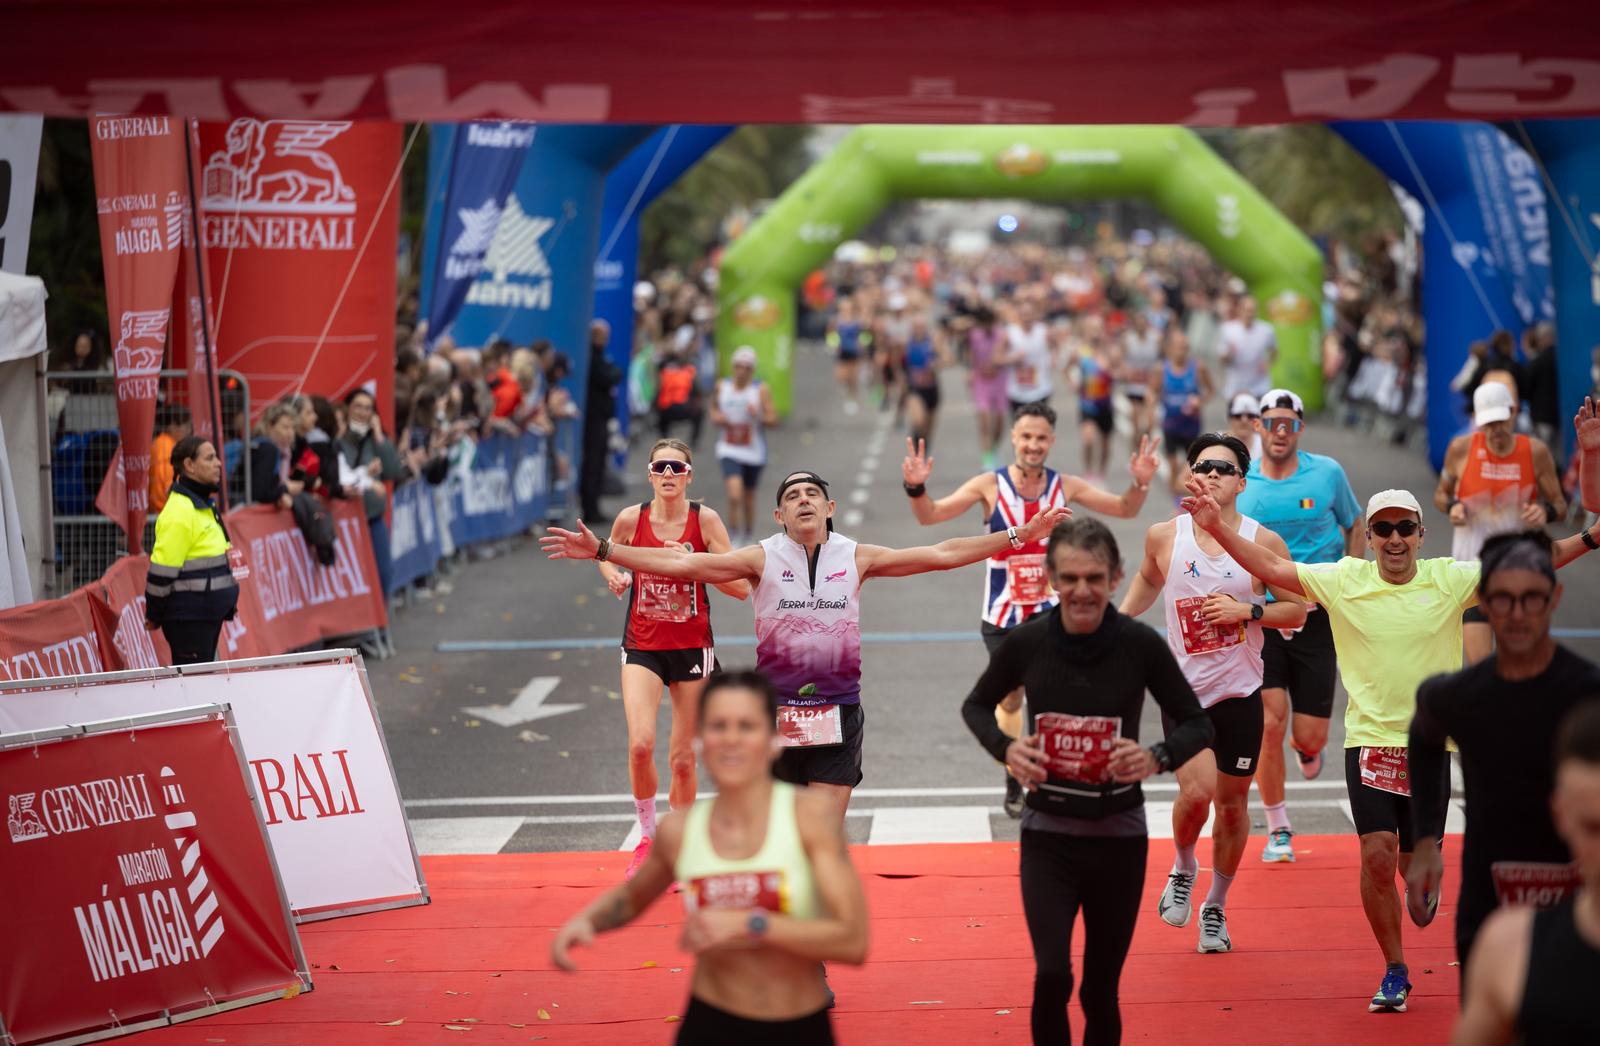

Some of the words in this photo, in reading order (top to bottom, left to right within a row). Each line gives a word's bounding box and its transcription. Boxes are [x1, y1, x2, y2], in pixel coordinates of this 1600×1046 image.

[203, 215, 354, 249] GENERALI
[649, 583, 677, 594] 1754
[776, 599, 805, 610] SIERRA
[813, 599, 846, 610] SEGURA
[783, 710, 823, 722] 12124
[1055, 733, 1093, 752] 1019
[41, 773, 156, 835] GENERALI
[117, 843, 171, 886] MARATÓN
[74, 885, 200, 982] MÁLAGA
